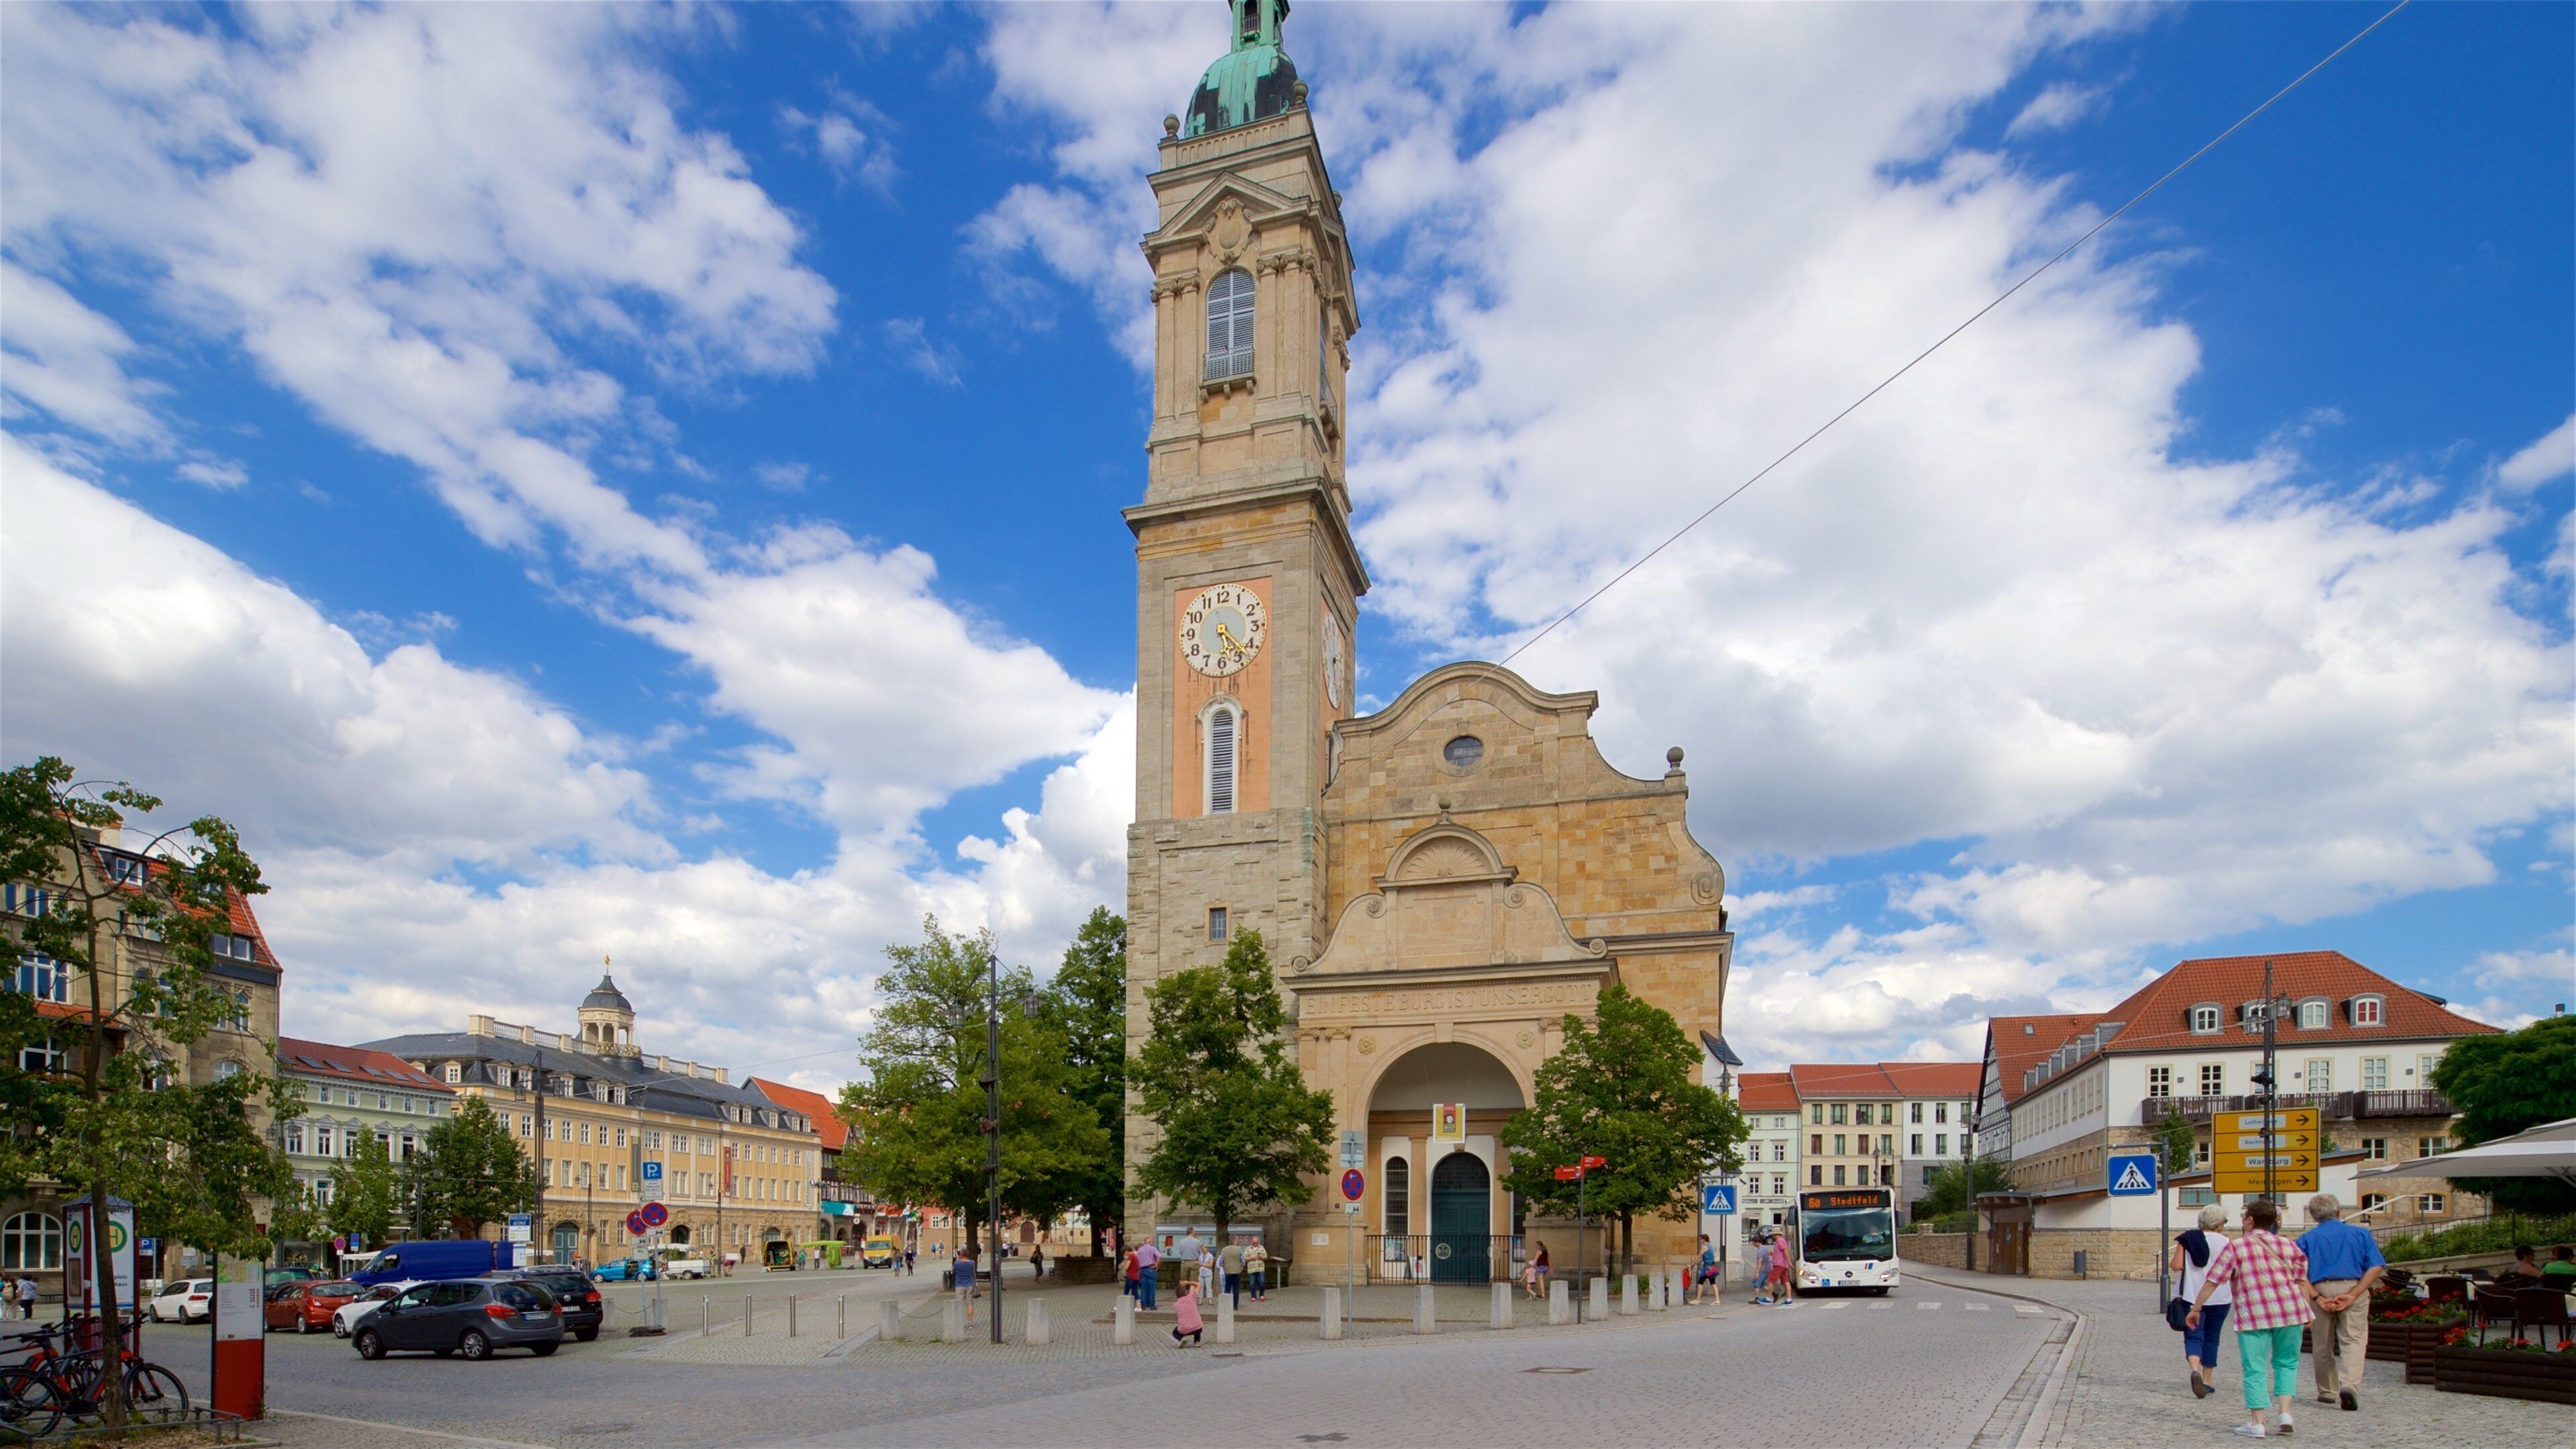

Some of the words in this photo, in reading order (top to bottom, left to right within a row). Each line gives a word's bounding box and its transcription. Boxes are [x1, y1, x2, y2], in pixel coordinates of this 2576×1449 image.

[1202, 597, 1212, 609] 11
[1217, 591, 1230, 604] 12
[1237, 594, 1240, 605] 1
[1246, 604, 1255, 616] 2
[1190, 611, 1203, 624] 10
[1250, 620, 1259, 632] 3
[1187, 629, 1195, 640] 9
[1245, 637, 1254, 649] 4
[1191, 644, 1200, 656] 8
[1202, 655, 1211, 667] 7
[1218, 657, 1226, 669] 6
[1234, 651, 1242, 663] 5
[1305, 997, 1335, 1014] EIN
[1338, 995, 1394, 1014] FESTE
[1479, 987, 1543, 1006] UNSER
[1544, 984, 1591, 1002] GOTT
[647, 1164, 657, 1177] P
[1809, 1197, 1821, 1208] 6a
[1830, 1195, 1878, 1206] Stedtfeld
[142, 1240, 150, 1248] P
